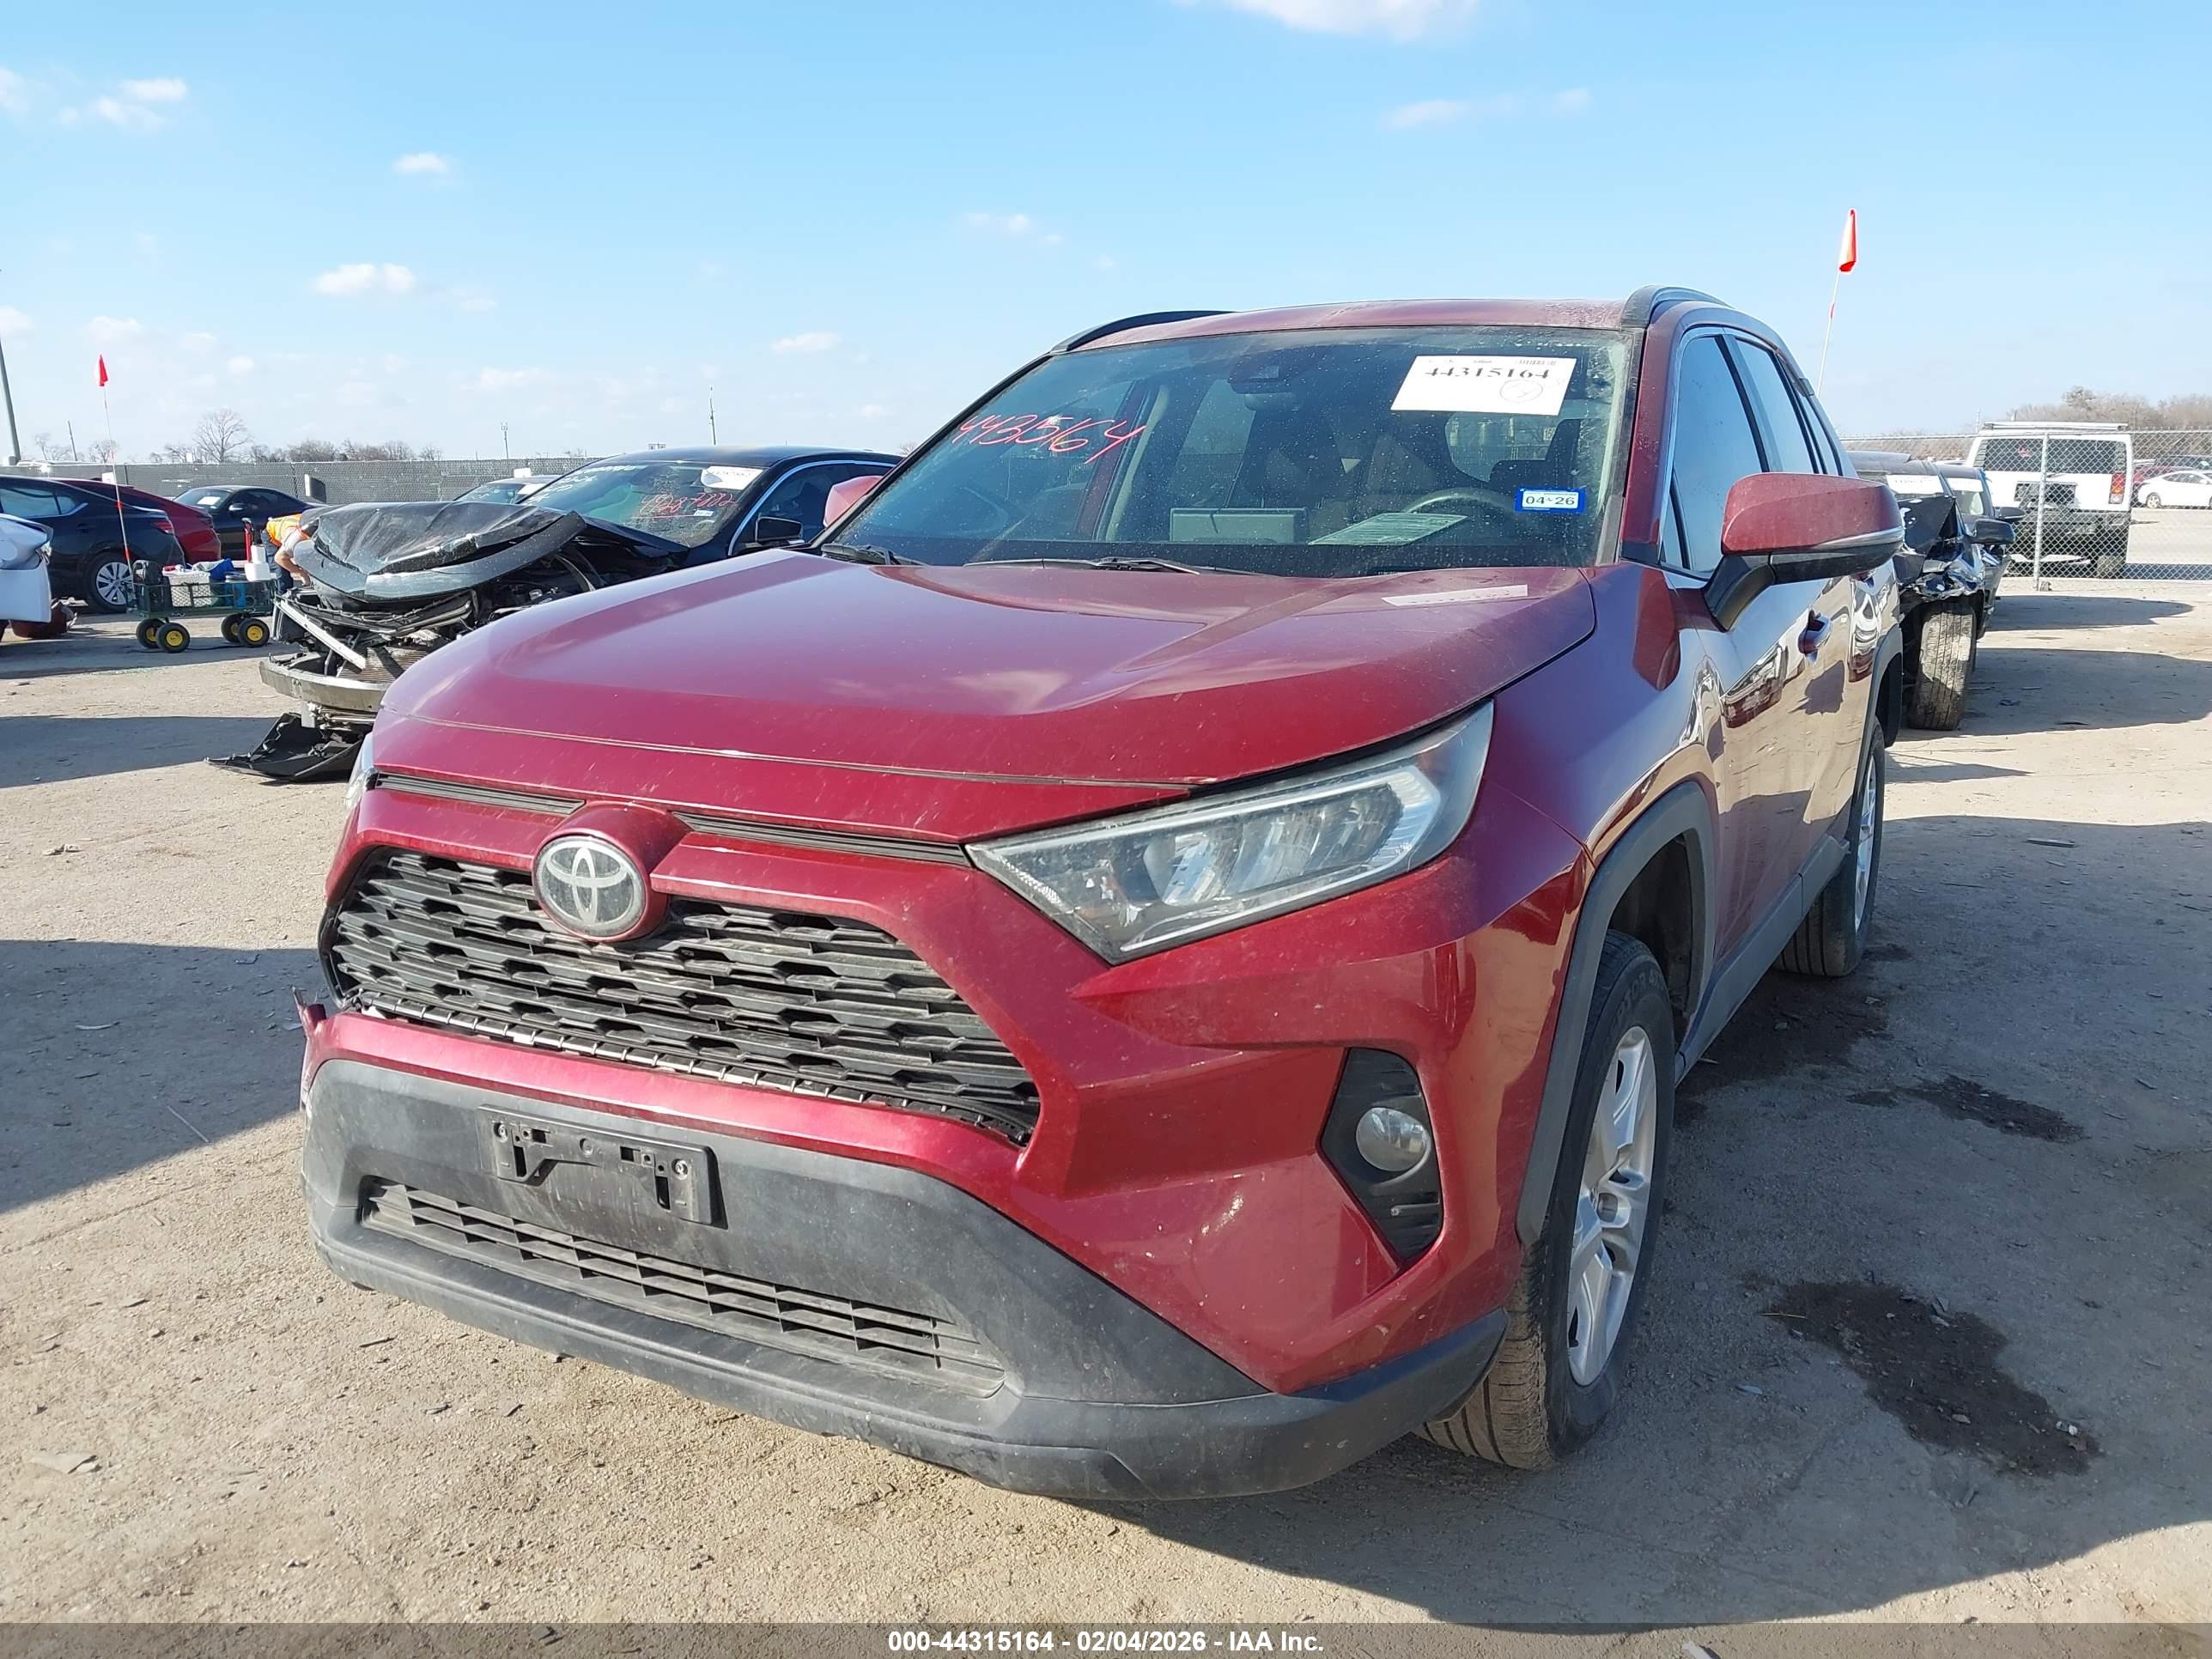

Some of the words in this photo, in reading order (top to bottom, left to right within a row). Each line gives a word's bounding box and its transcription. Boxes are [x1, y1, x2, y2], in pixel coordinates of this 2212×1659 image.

[1425, 367, 1550, 380] 44315164
[1525, 495, 1545, 505] 04
[1554, 496, 1575, 506] 26
